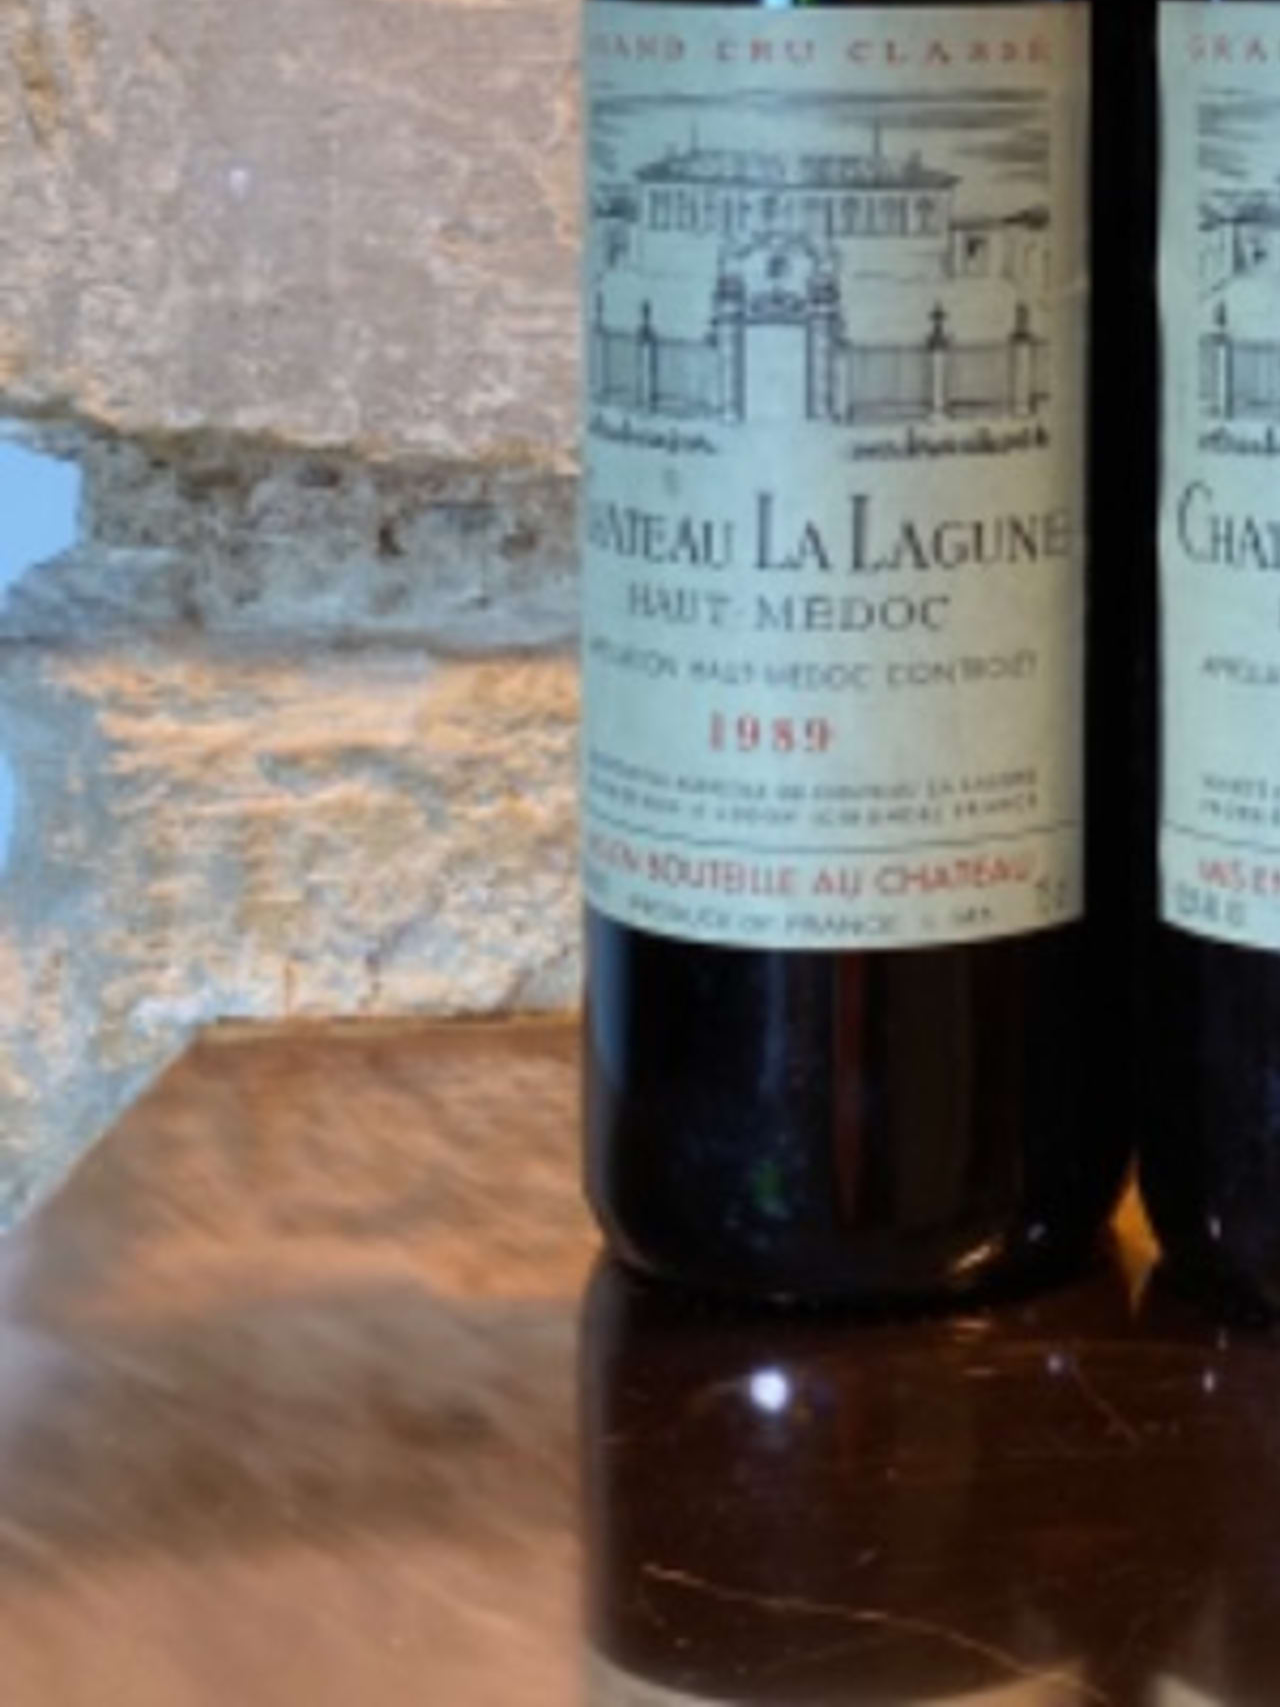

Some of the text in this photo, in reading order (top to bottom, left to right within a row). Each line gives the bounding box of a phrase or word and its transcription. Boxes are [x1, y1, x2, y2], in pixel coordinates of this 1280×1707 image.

[715, 39, 815, 66] CRU
[754, 491, 831, 570] LA
[848, 493, 1072, 571] LAGUNE
[628, 581, 731, 627] HAUT
[708, 709, 834, 753] 1989
[813, 865, 862, 899] AU
